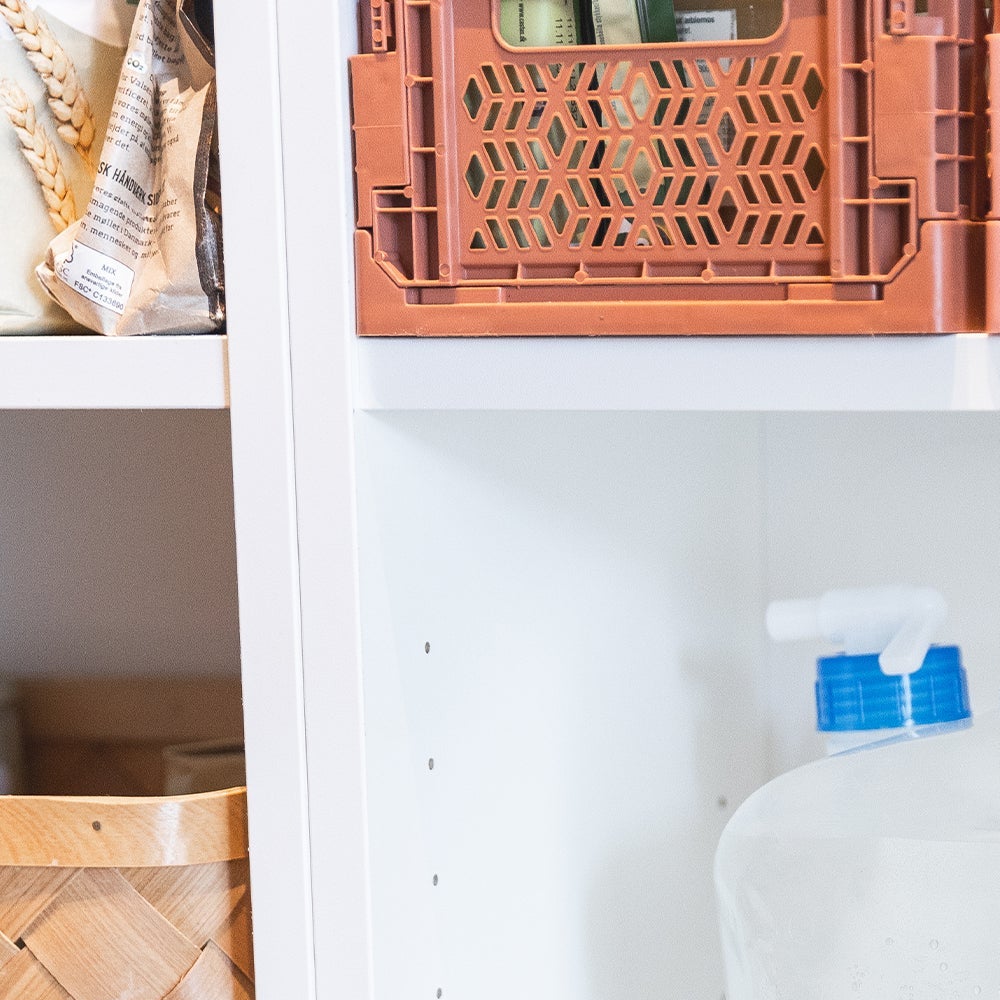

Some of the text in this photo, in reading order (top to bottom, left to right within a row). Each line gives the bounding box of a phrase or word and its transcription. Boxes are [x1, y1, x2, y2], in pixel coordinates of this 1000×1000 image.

[112, 167, 147, 206] HÅNDVÆRK
[90, 226, 132, 254] mennesker
[101, 263, 117, 276] MIX
